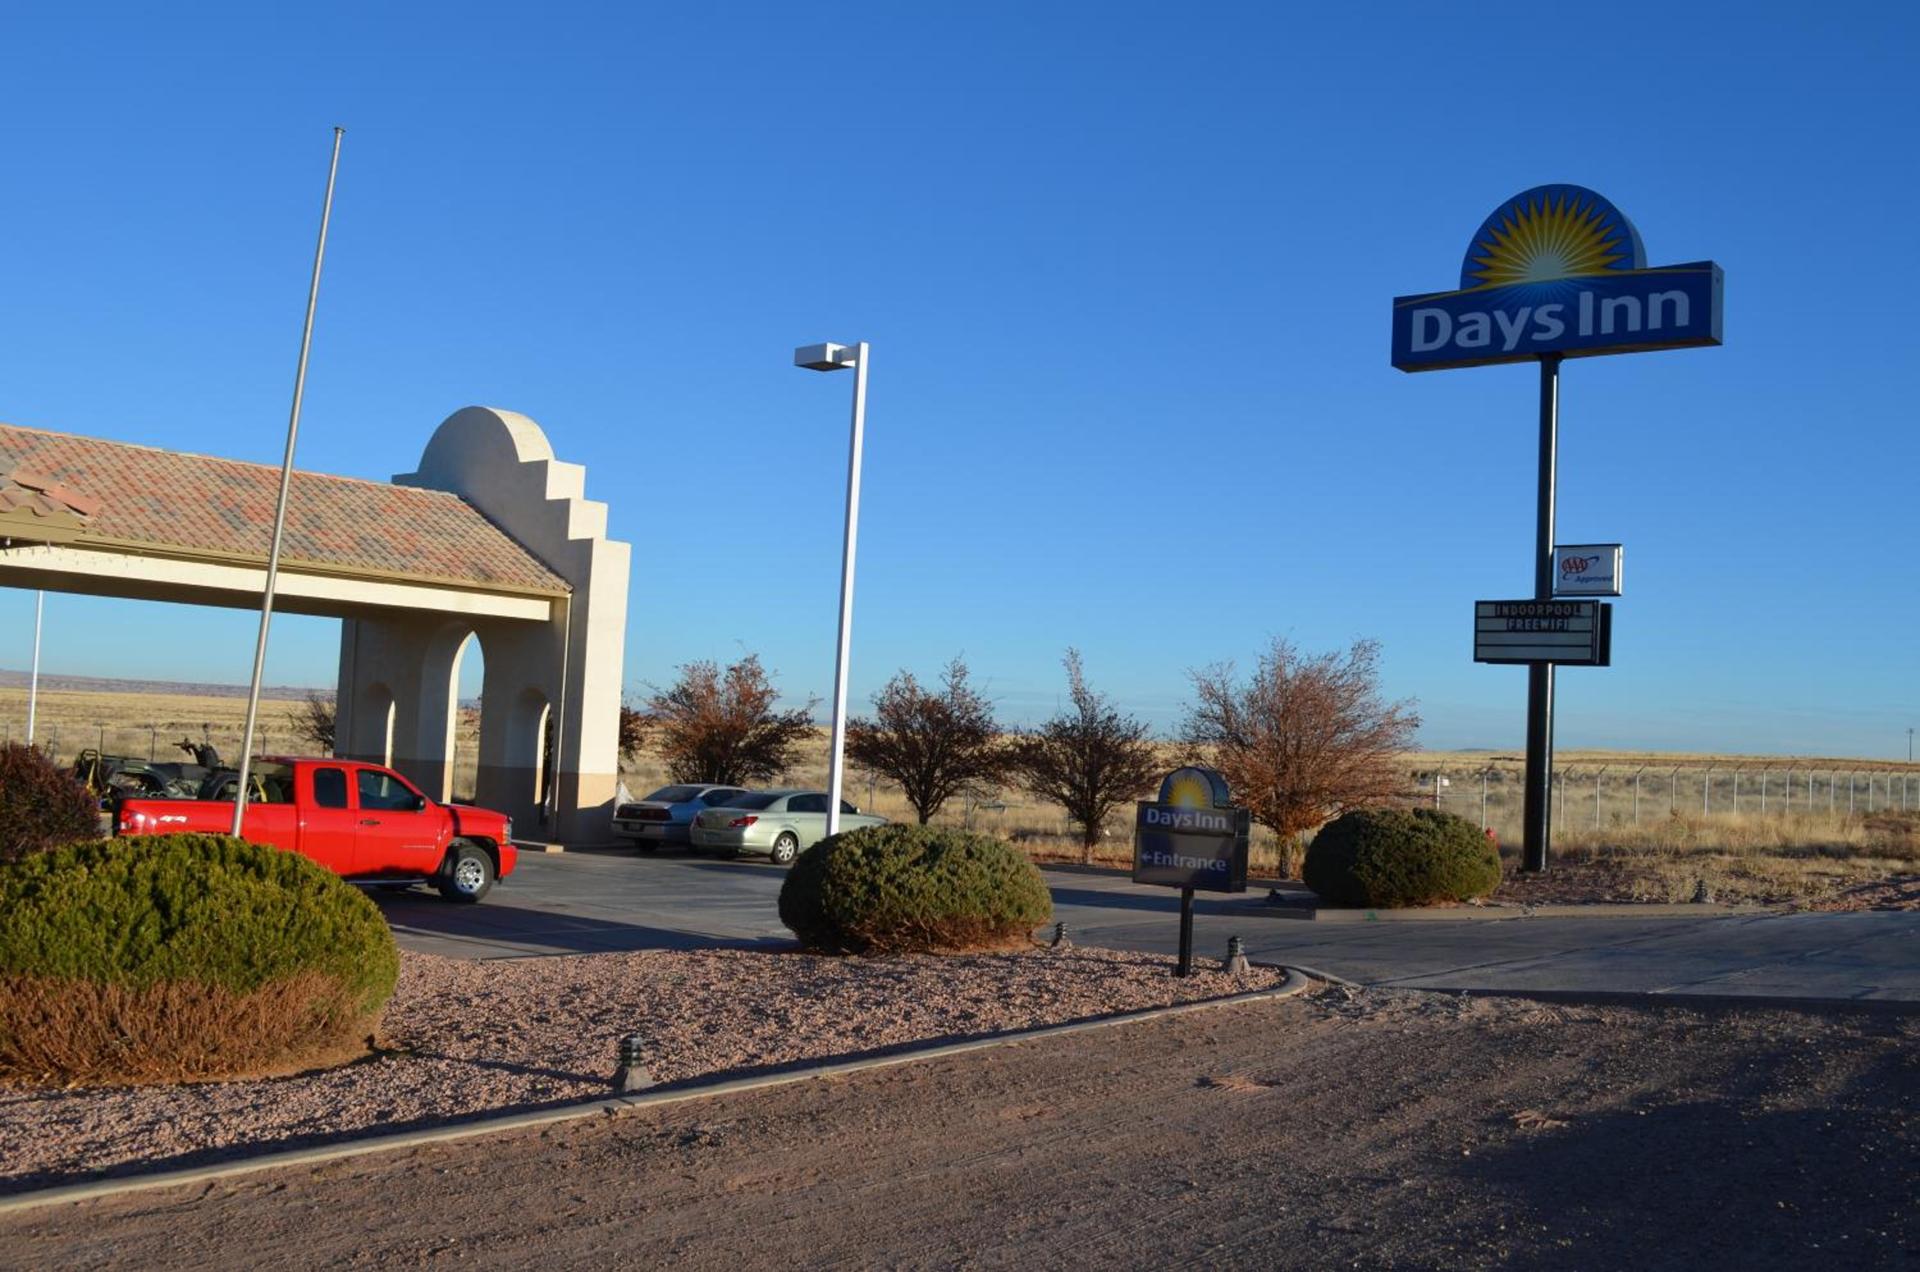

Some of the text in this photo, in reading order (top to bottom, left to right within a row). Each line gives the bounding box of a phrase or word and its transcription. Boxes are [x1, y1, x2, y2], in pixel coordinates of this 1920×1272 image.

[1410, 289, 1690, 353] Days Inn
[1146, 808, 1227, 829] Days Inn
[1154, 851, 1227, 871] Entrance
